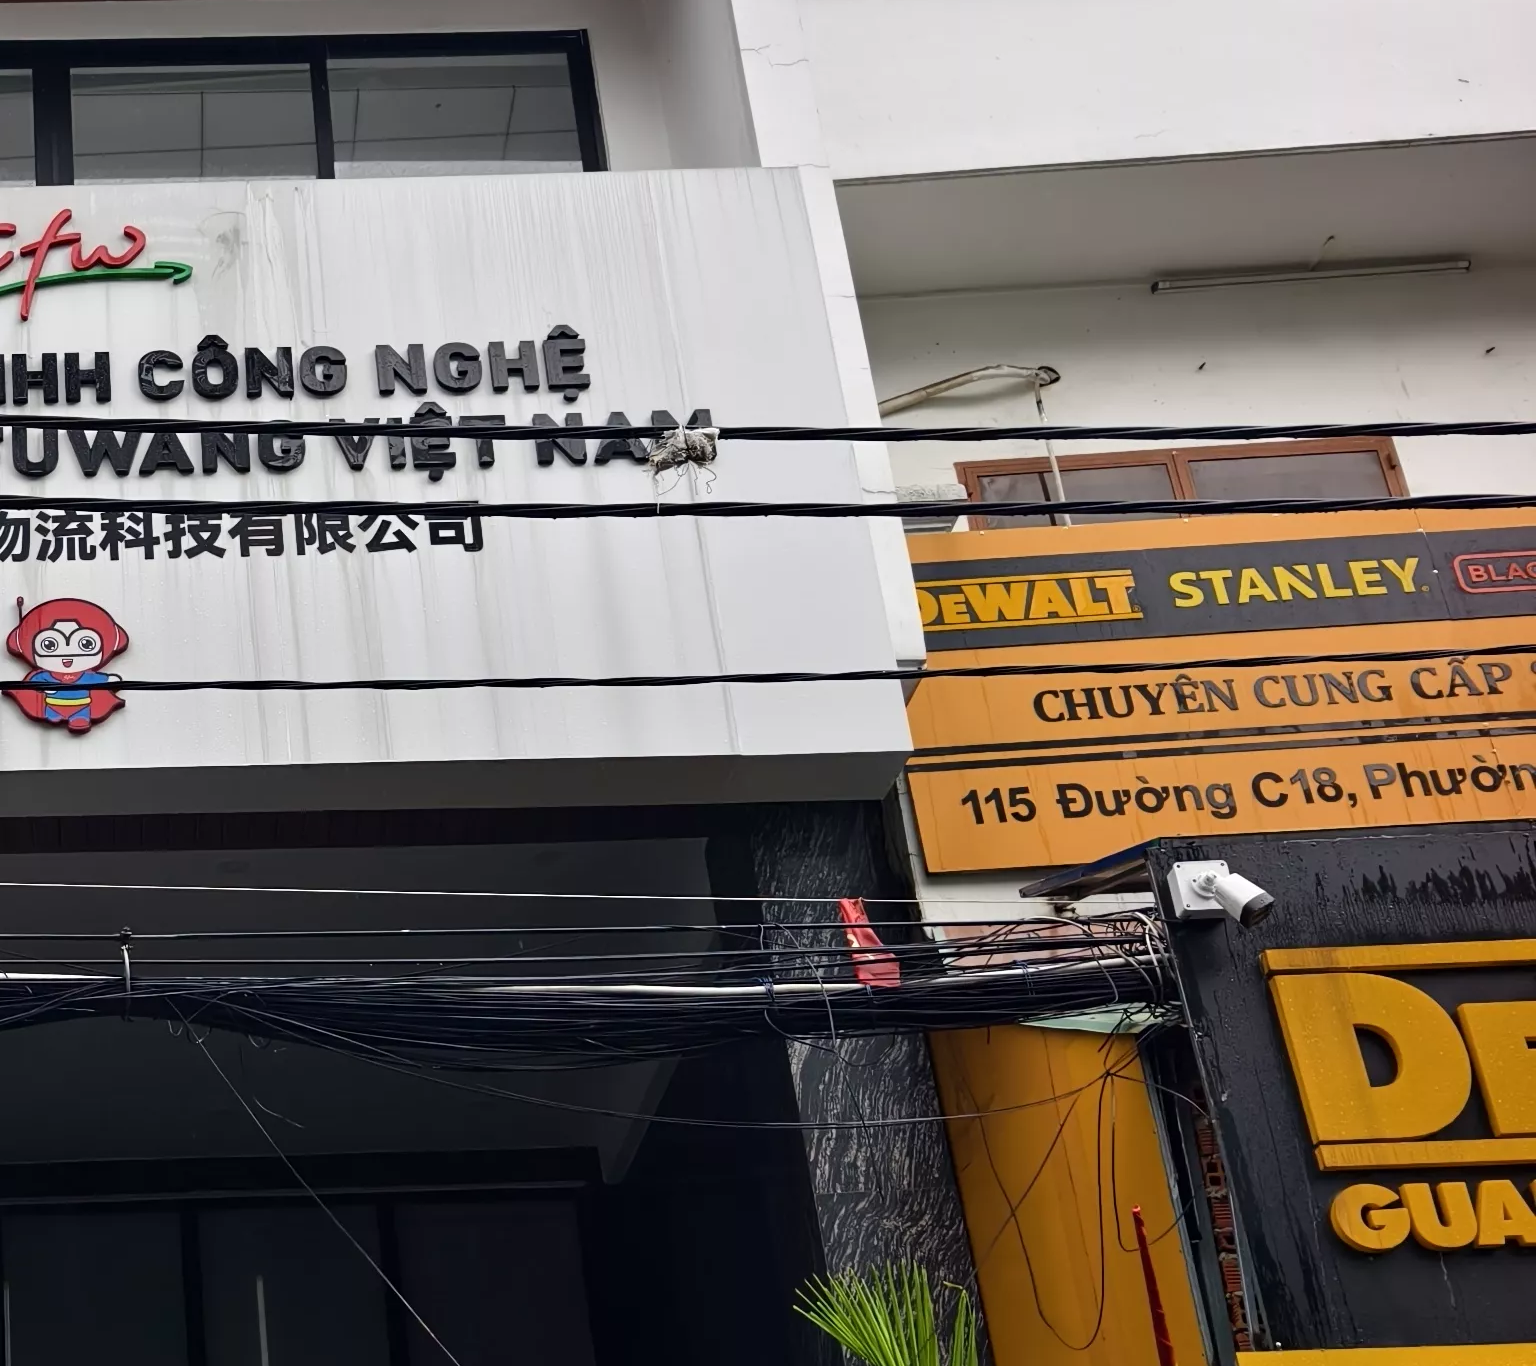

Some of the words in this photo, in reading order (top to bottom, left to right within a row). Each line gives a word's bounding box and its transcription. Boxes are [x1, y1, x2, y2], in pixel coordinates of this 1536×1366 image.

[137, 335, 348, 401] CÔNG
[375, 324, 591, 402] NGHỆ
[329, 401, 505, 482] VIỆT
[1169, 556, 1420, 608] STANLEY
[1032, 674, 1239, 723] CHUYÊN
[1252, 669, 1393, 709] CUNG
[1410, 656, 1512, 699] CẤP
[961, 786, 1037, 826] 115
[1056, 775, 1237, 820] Đường
[1330, 1180, 1536, 1253] GUA
